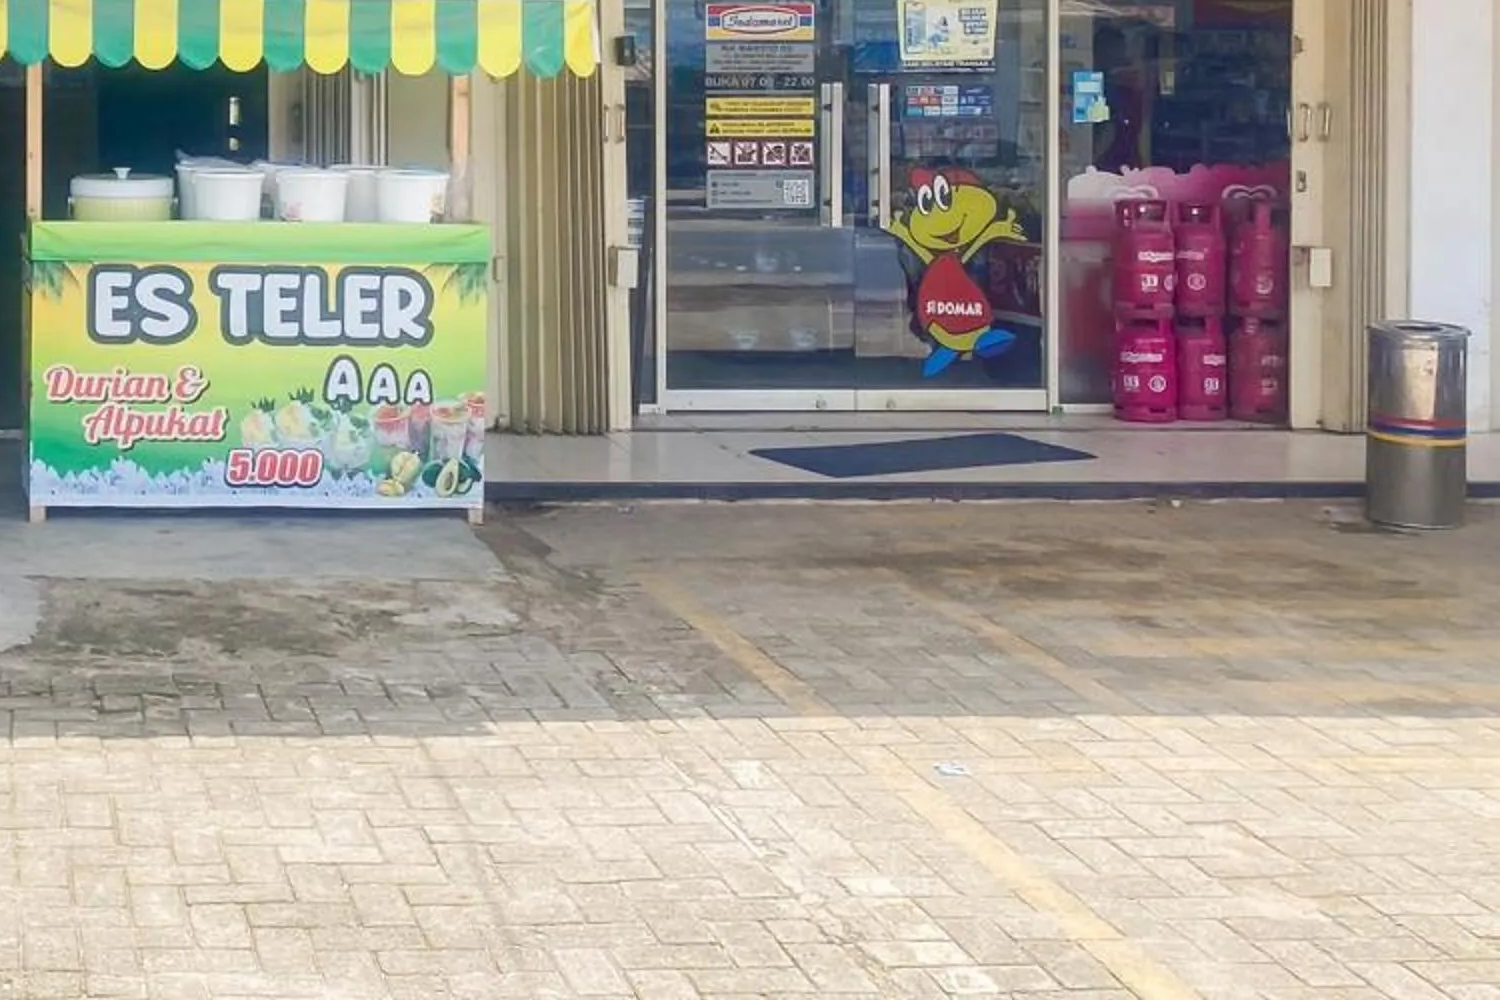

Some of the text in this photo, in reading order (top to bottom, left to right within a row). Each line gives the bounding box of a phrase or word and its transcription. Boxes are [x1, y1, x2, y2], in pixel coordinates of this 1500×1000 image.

[89, 267, 431, 343] ES TELER
[46, 366, 206, 402] Durian &
[84, 407, 227, 447] Alpukat
[227, 450, 322, 485] 5.000
